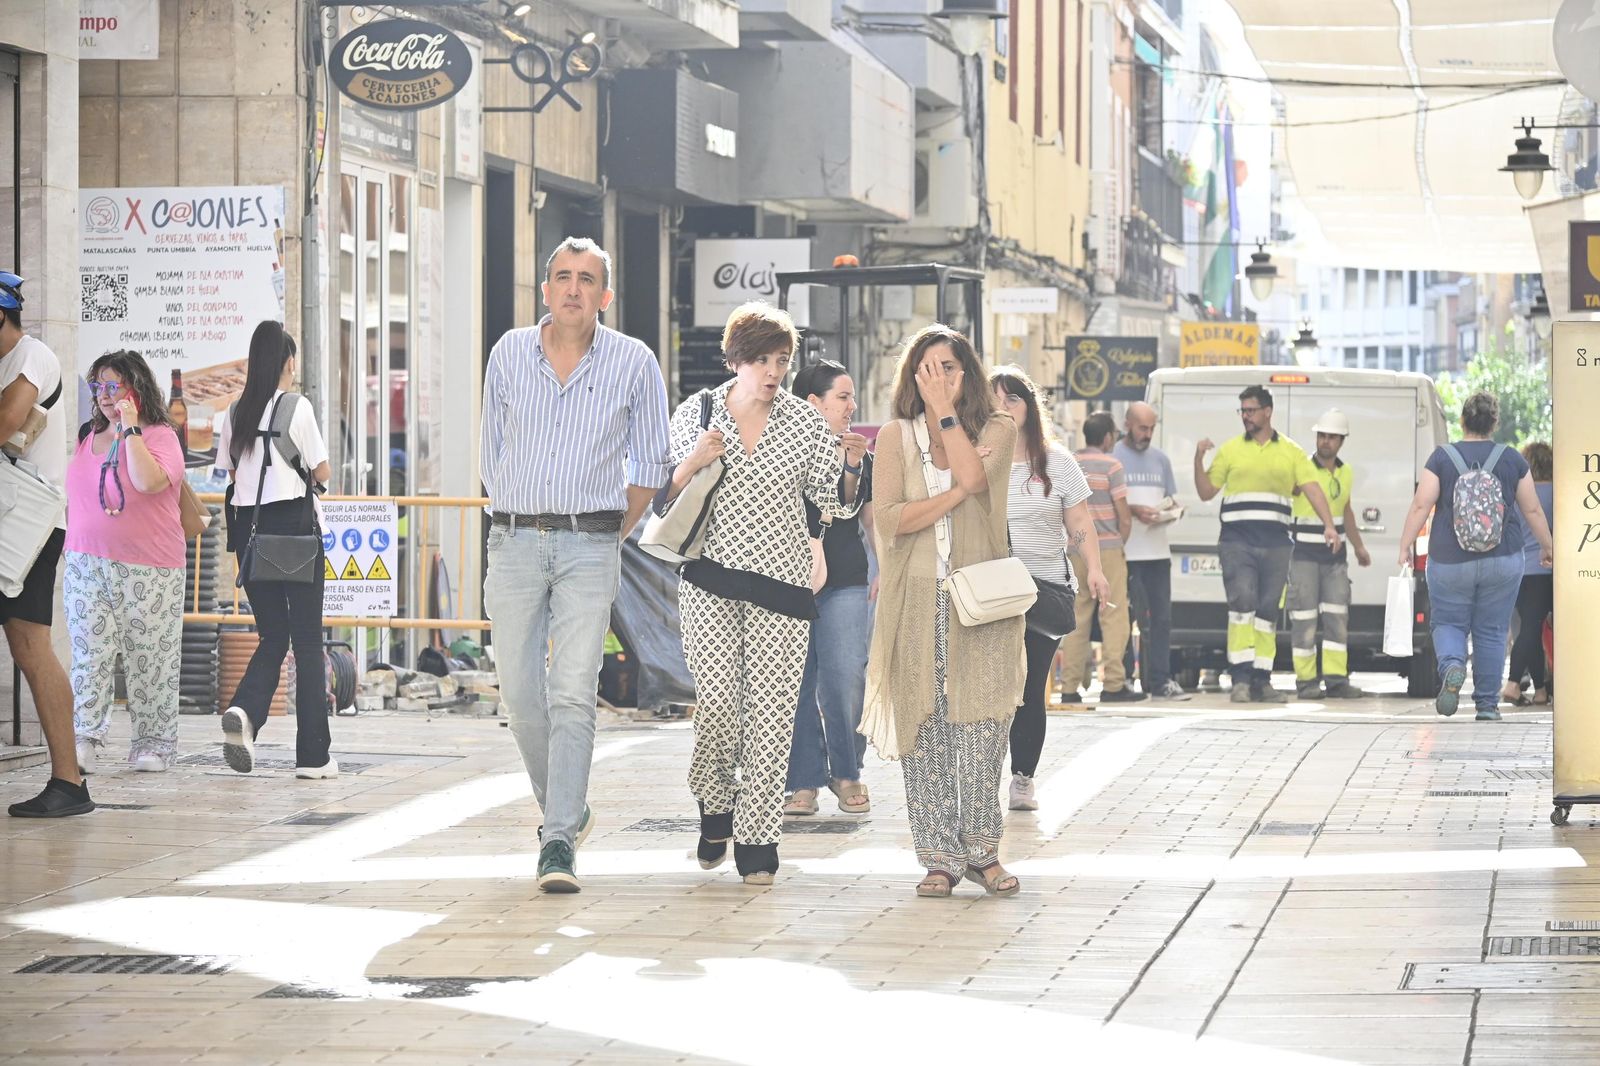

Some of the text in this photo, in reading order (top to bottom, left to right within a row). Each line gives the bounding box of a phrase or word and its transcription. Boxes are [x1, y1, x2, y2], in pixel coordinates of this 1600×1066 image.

[79, 36, 96, 46] AL
[342, 33, 448, 72] Coca-Cola
[362, 78, 441, 95] CERVECERIA
[366, 88, 437, 104] XCAJONES
[152, 196, 268, 230] C@JONES
[83, 246, 136, 254] MATALASCAÑAS
[156, 270, 184, 280] MOJAMA
[186, 271, 196, 280] DE
[134, 286, 157, 298] GAMBA
[160, 286, 184, 296] BLANCA
[186, 286, 196, 295] DE
[186, 316, 196, 325] DE
[186, 331, 196, 340] DE
[344, 504, 356, 512] LAS
[358, 504, 386, 512] NORMAS
